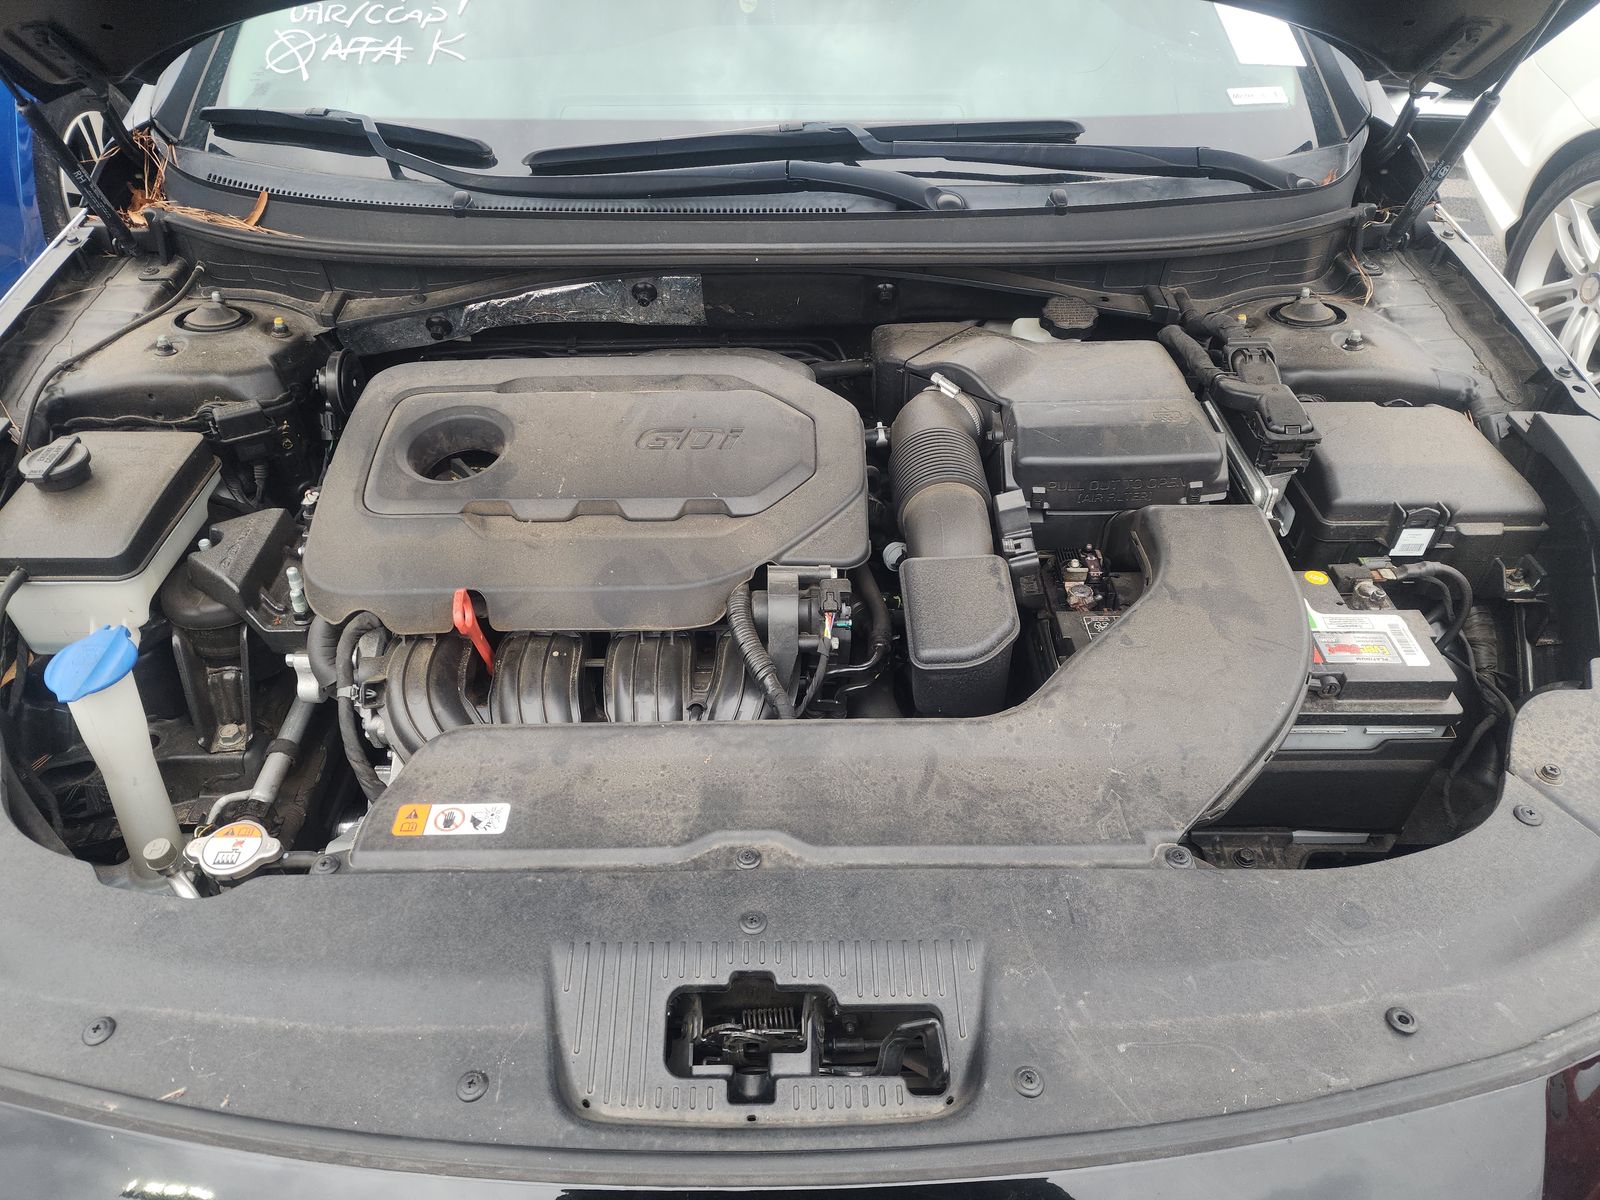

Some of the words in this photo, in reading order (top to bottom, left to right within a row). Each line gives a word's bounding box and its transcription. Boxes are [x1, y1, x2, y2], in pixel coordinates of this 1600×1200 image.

[426, 29, 467, 65] K
[73, 170, 87, 184] RH
[1046, 481, 1085, 492] PULL
[1089, 480, 1121, 491] OUT
[1122, 479, 1143, 490] TO
[1146, 477, 1186, 490] OPEN
